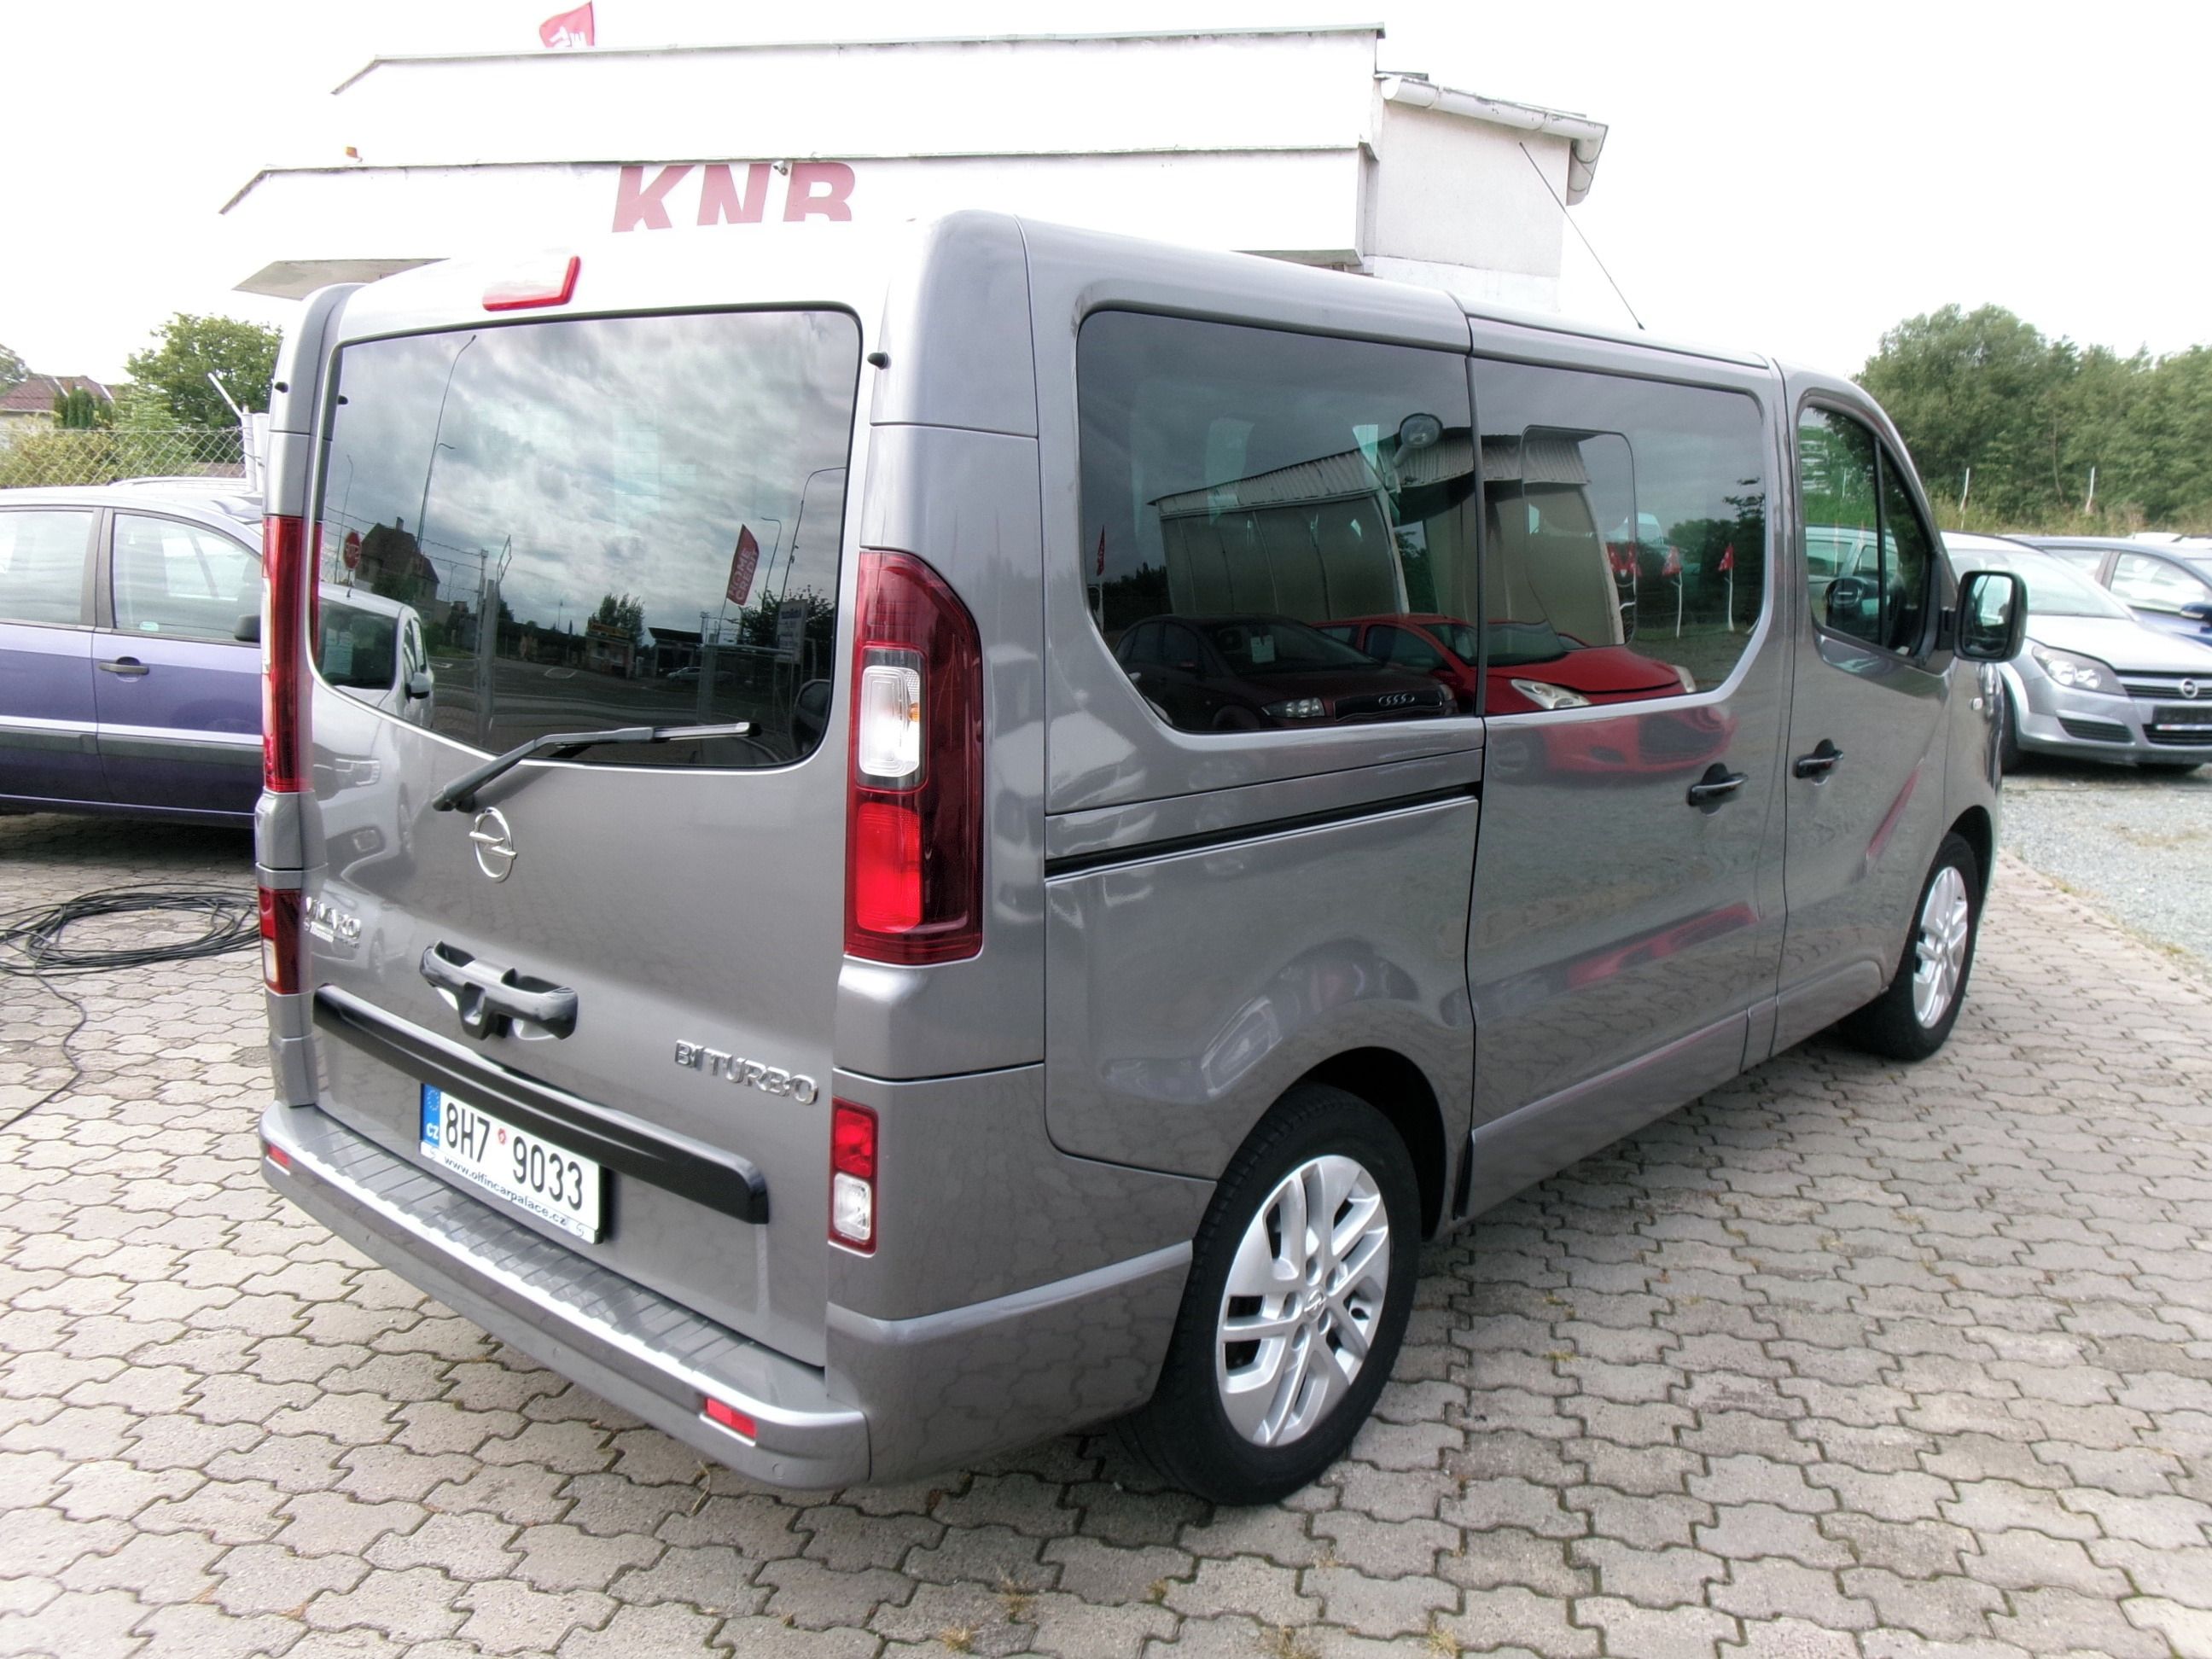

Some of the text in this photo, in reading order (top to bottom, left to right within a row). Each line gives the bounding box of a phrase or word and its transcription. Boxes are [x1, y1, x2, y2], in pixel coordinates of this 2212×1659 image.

[426, 1122, 439, 1141] CZ
[445, 1102, 583, 1212] 8H7 9033
